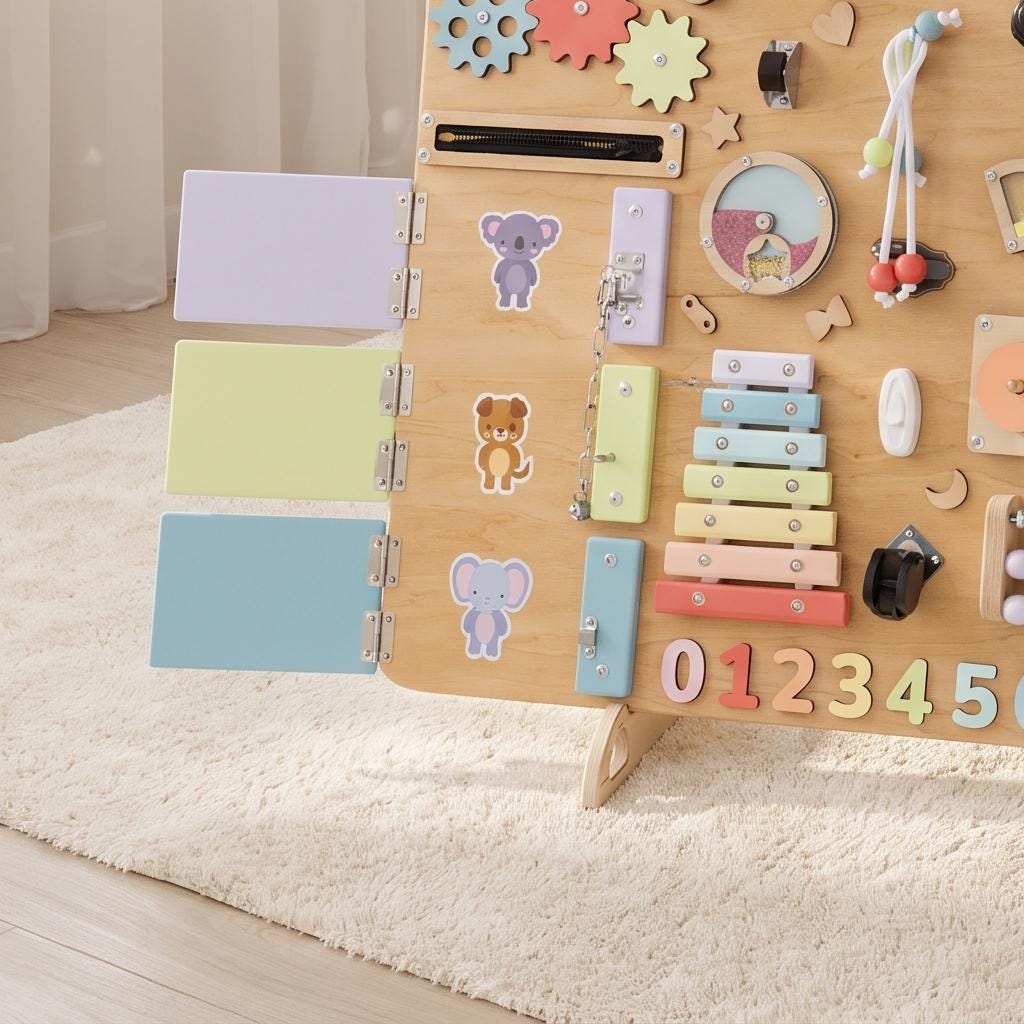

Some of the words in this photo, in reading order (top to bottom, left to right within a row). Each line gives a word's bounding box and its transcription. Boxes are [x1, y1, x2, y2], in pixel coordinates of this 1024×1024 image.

[661, 638, 706, 703] 0
[718, 642, 760, 709] 1
[772, 648, 815, 714] 2
[828, 652, 872, 719] 3
[886, 658, 933, 725] 4
[952, 662, 998, 729] 5
